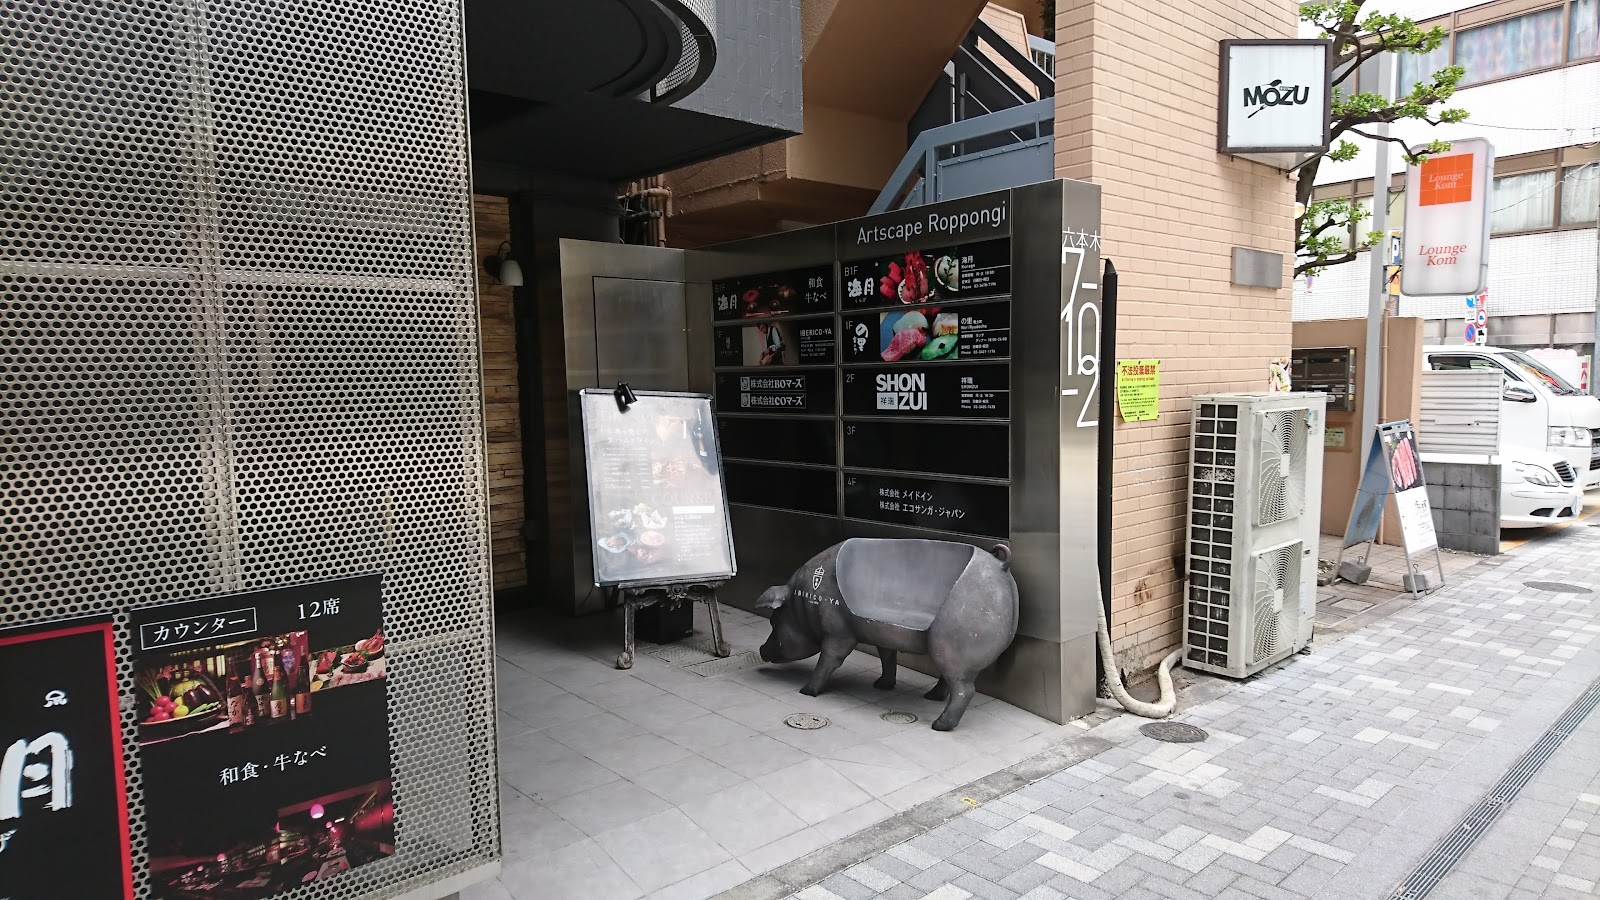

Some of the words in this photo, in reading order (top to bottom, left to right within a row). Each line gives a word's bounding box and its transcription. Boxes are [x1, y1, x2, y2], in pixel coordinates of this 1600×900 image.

[1243, 85, 1310, 107] MOZU
[1428, 172, 1464, 182] Lounge
[1434, 181, 1457, 190] Kom
[857, 221, 923, 244] Artscape
[928, 200, 1006, 234] Roppongi
[1062, 227, 1101, 251] 六本木
[1419, 245, 1467, 256] Lounge
[1427, 256, 1457, 266] Kom
[844, 266, 858, 277] B1F
[808, 276, 823, 289] 和食
[805, 291, 827, 304] 牛なべ
[846, 320, 854, 331] 1F
[1121, 365, 1156, 376] 不法投棄厳禁
[845, 373, 855, 383] 2F
[876, 373, 925, 392] SHON
[898, 391, 928, 410] ZUI
[846, 425, 856, 435] 3F
[847, 477, 857, 487] 4F
[879, 488, 900, 498] 株式会社
[902, 490, 933, 502] メイドイン
[879, 501, 900, 512] 株式会社
[902, 503, 966, 519] エコサンガ・ジャパン
[297, 597, 341, 620] 12席
[153, 617, 247, 644] カウンター
[218, 744, 327, 787] 和食・牛なべ
